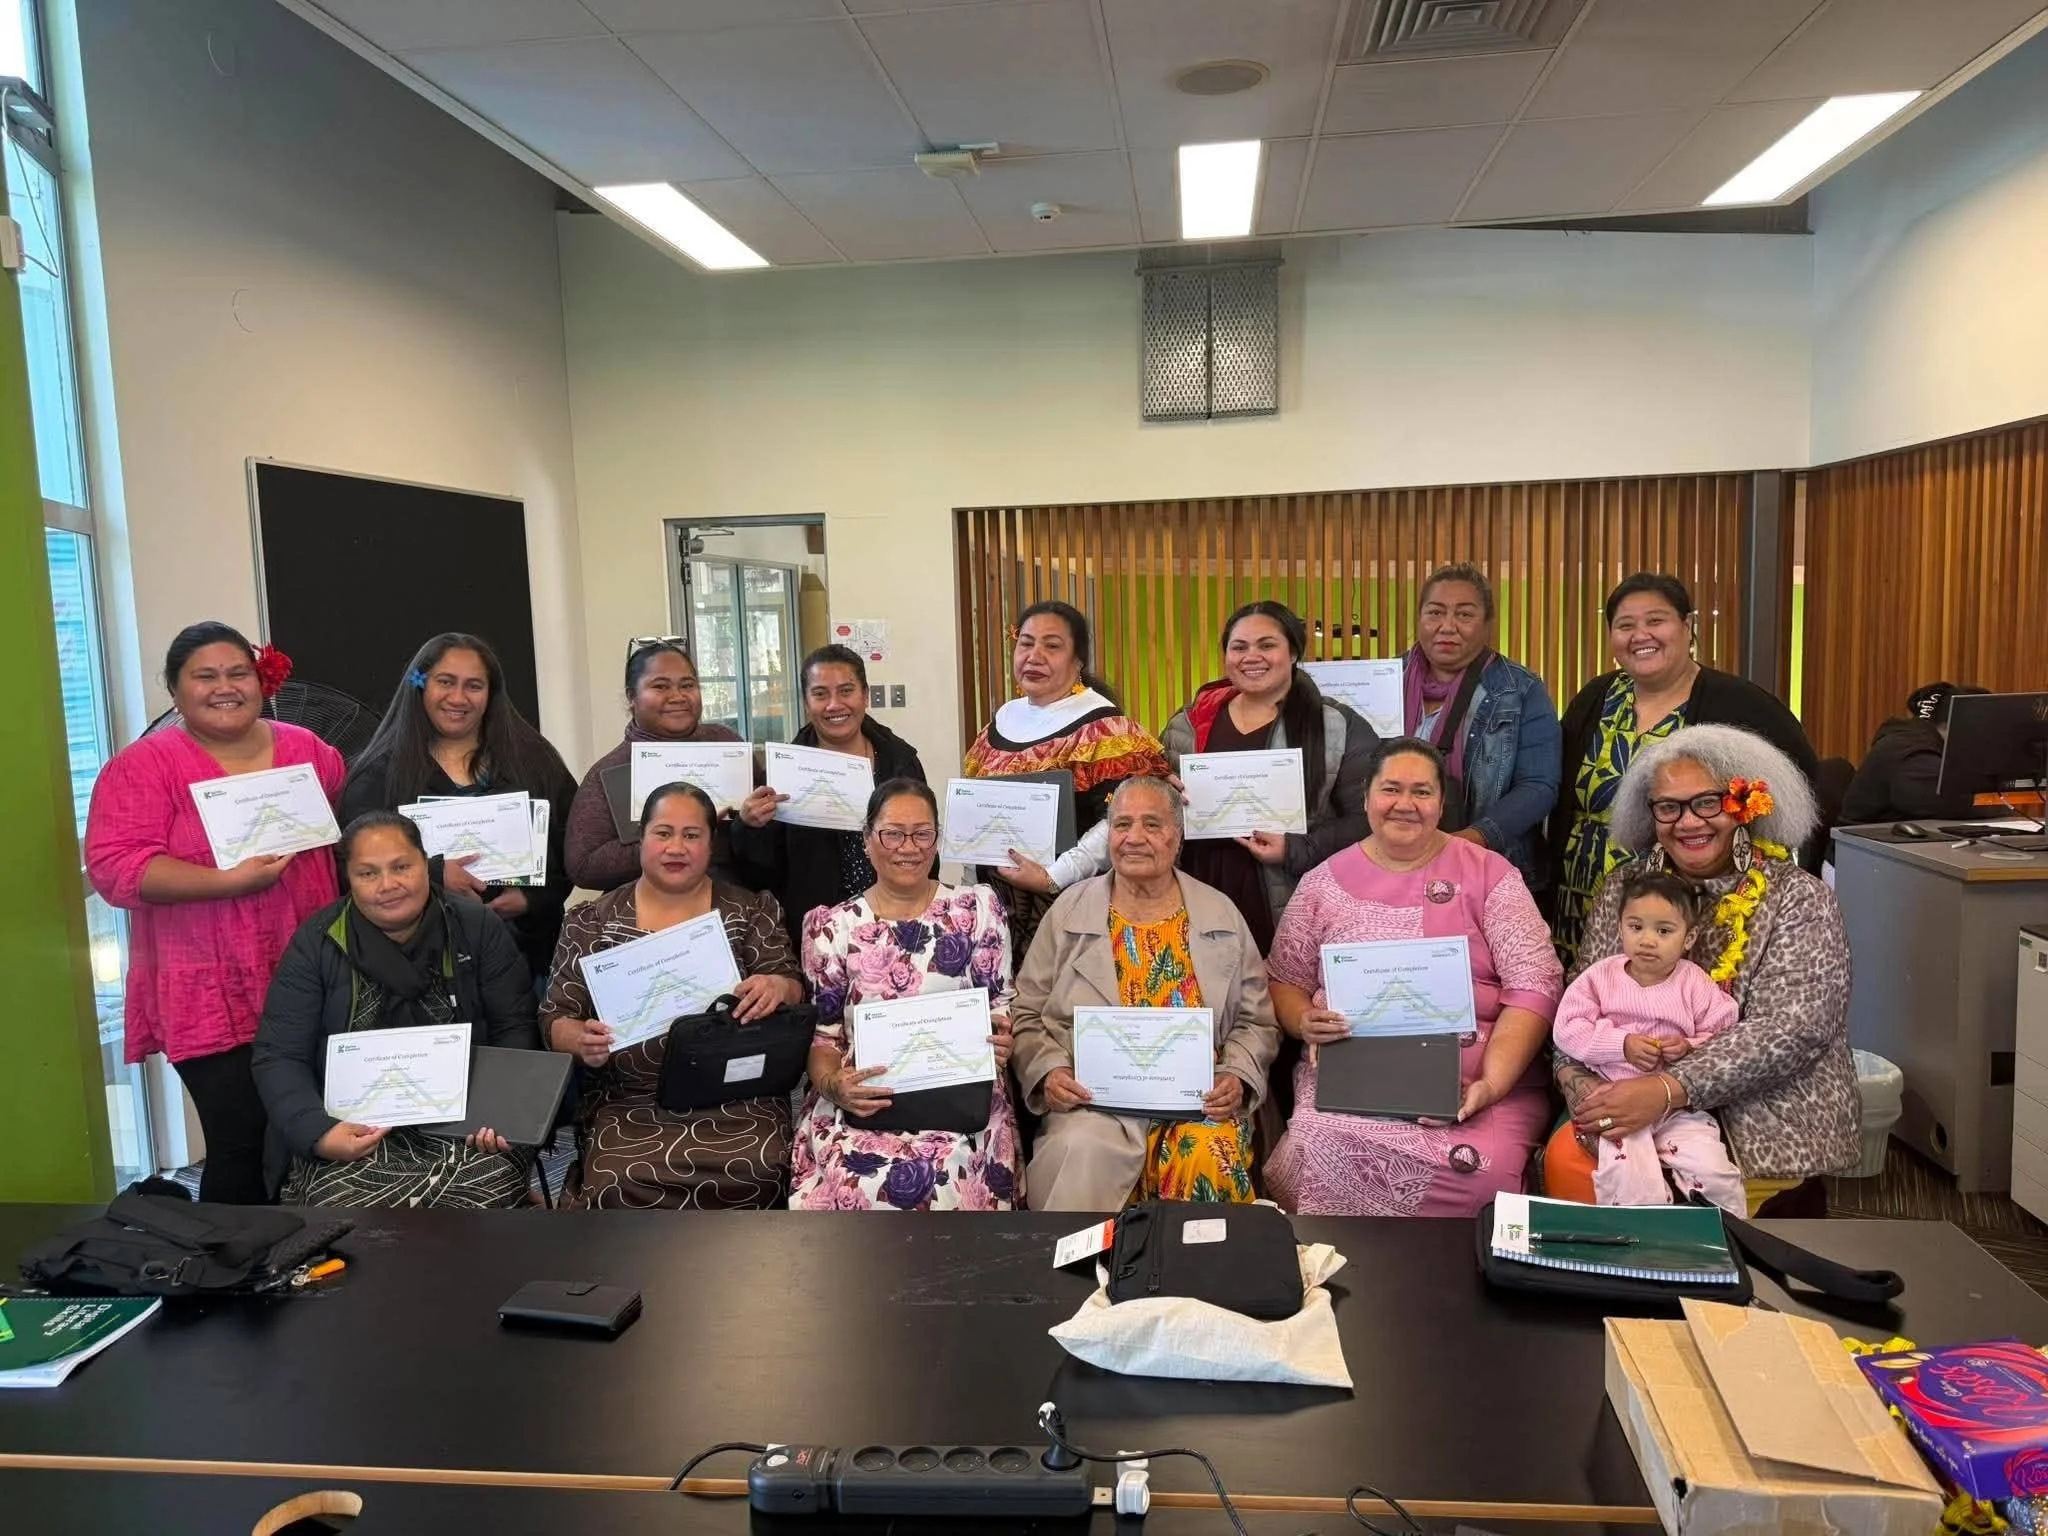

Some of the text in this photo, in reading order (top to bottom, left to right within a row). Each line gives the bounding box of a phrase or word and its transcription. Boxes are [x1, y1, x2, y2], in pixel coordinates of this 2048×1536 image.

[42, 1304, 81, 1328] Skills
[43, 1304, 97, 1337] Literacy
[70, 1304, 113, 1330] Digital
